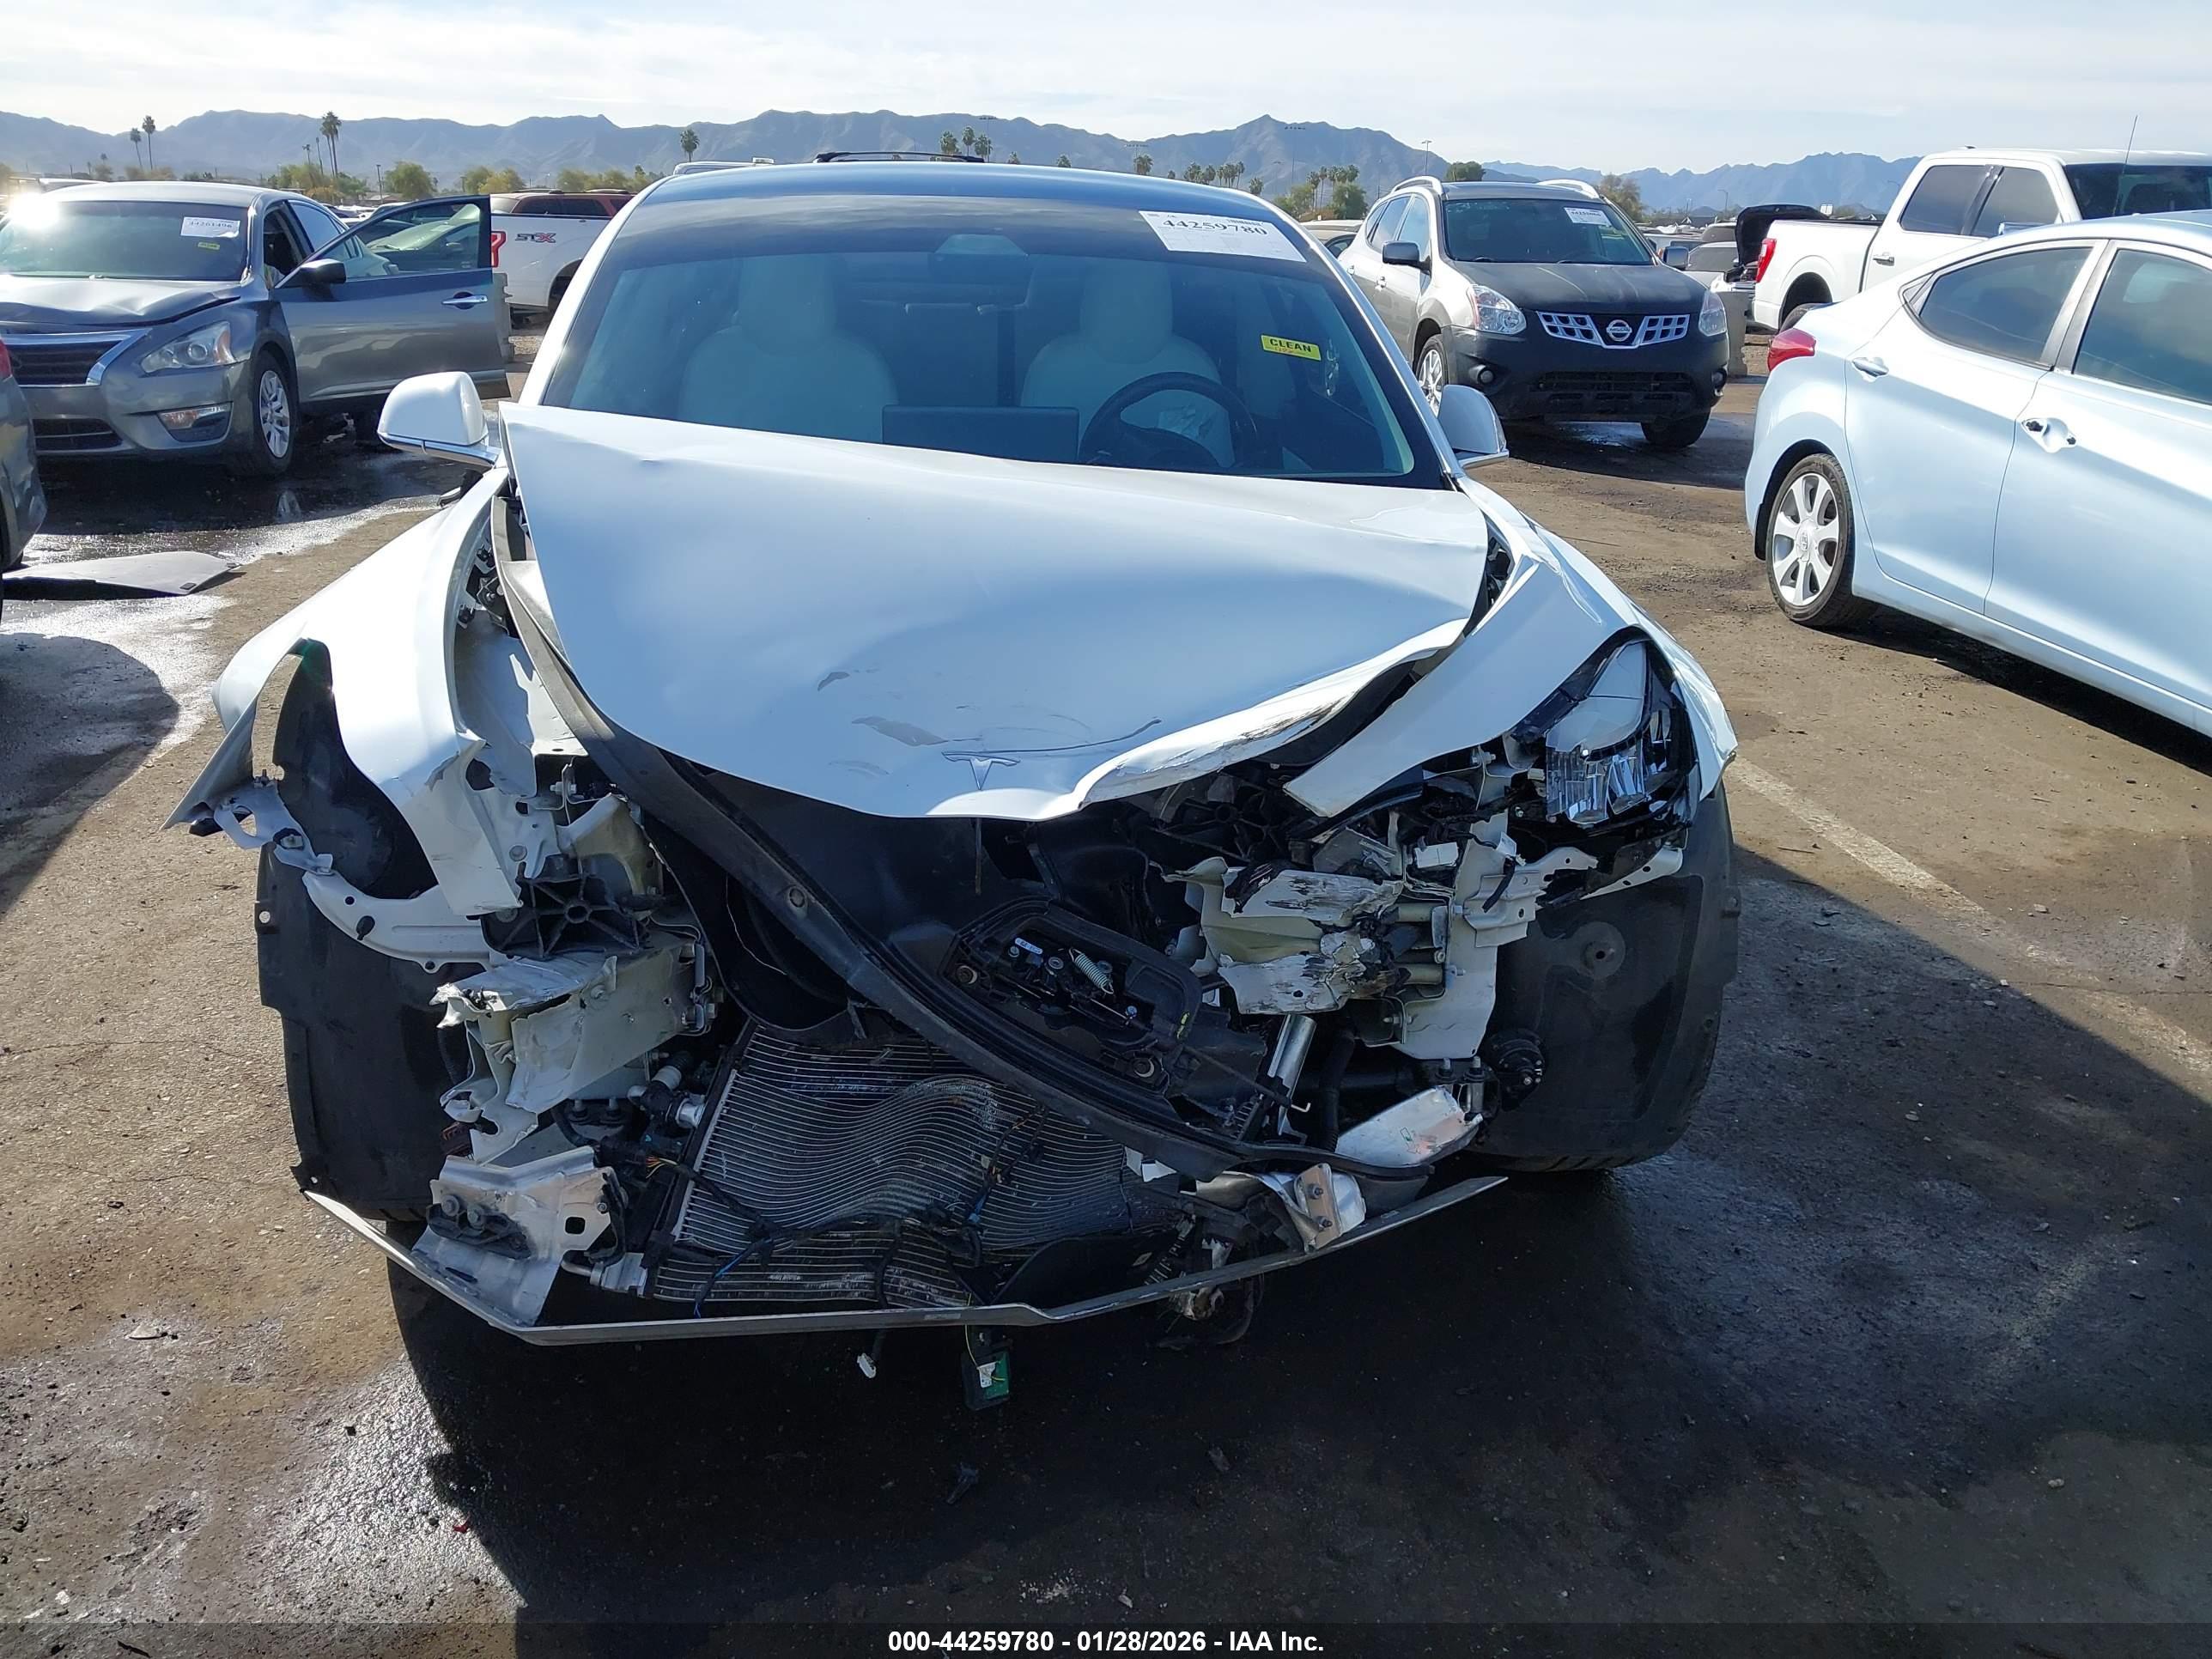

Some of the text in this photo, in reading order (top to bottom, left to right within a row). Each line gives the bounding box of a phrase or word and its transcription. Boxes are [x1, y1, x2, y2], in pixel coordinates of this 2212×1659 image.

[1163, 219, 1267, 235] 44259780
[514, 233, 556, 243] STX
[1269, 338, 1311, 352] CLEAN
